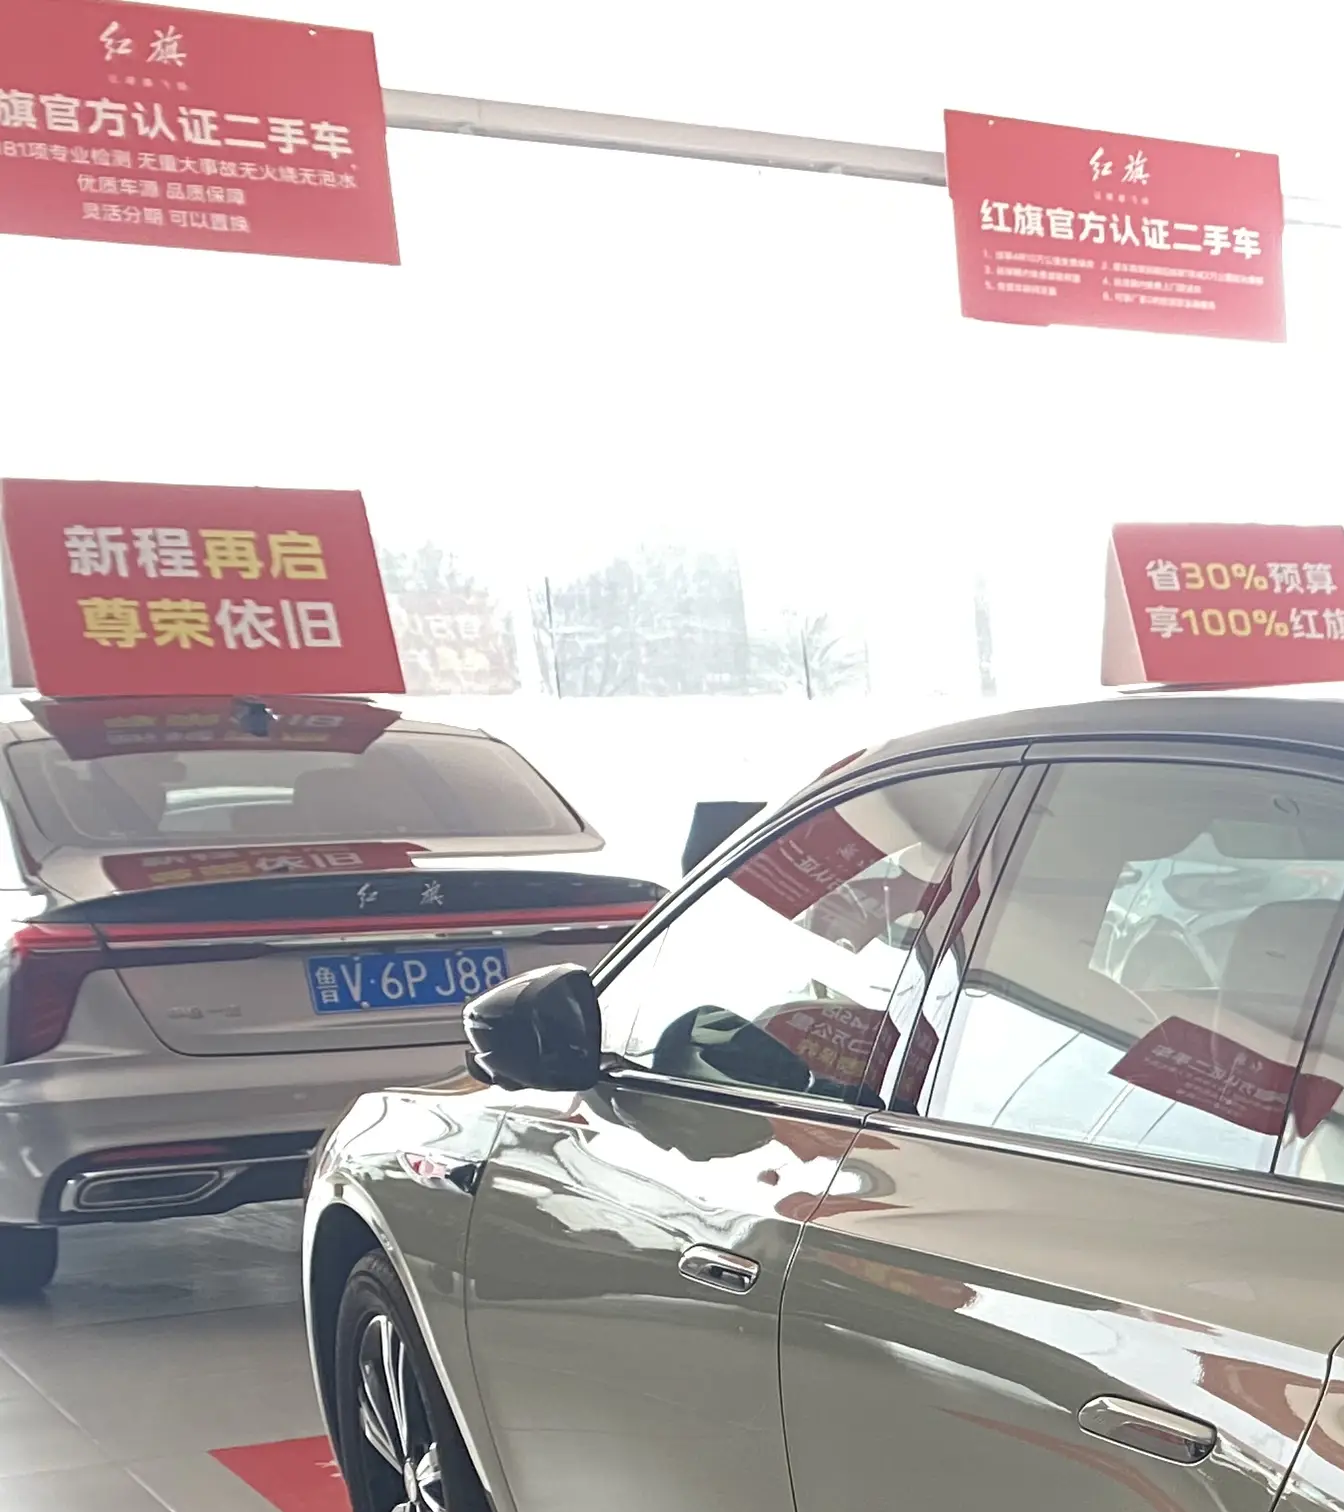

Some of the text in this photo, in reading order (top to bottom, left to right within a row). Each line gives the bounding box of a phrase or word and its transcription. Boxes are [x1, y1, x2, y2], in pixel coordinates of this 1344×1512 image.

[98, 20, 188, 67] 红旗
[1088, 146, 1152, 186] 红旗
[979, 198, 1263, 261] 红旗官方认证二手车
[62, 525, 329, 580] 新程再启
[1144, 558, 1338, 595] 省30%预算
[76, 596, 343, 650] 尊荣依旧
